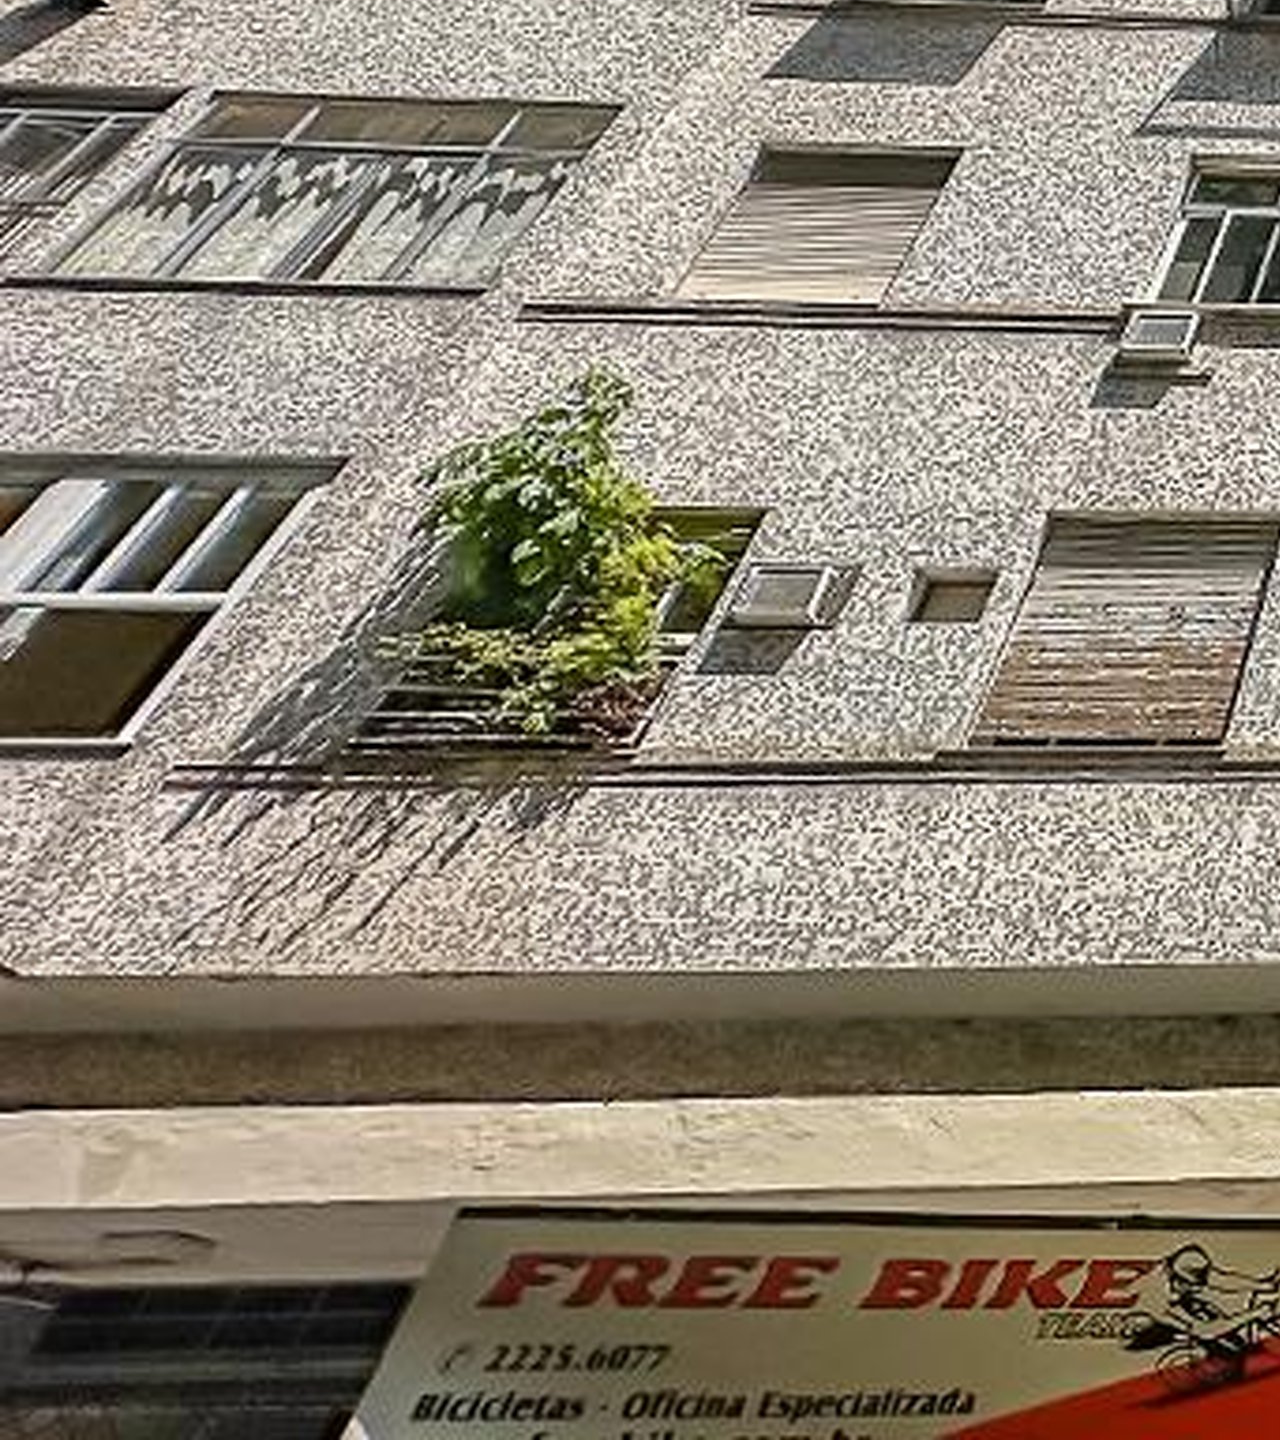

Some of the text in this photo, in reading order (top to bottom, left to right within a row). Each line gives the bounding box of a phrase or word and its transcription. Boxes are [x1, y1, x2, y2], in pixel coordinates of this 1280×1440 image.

[474, 1254, 1164, 1310] FREE BIKE
[483, 1344, 671, 1372] 2225.6077
[410, 1390, 585, 1423] Bicicletas
[620, 1389, 748, 1420] Oficina
[756, 1387, 976, 1424] Especializada
